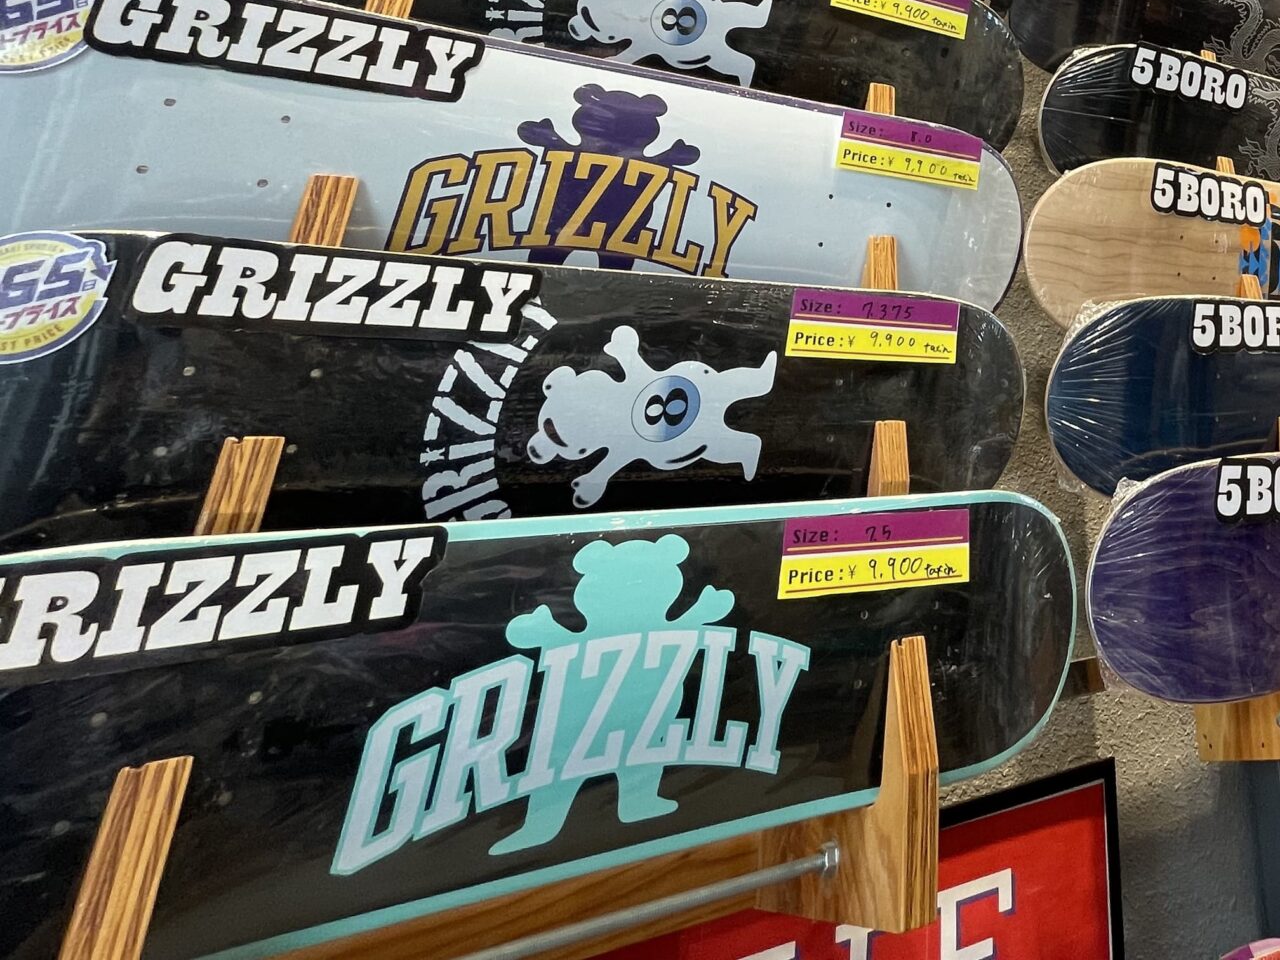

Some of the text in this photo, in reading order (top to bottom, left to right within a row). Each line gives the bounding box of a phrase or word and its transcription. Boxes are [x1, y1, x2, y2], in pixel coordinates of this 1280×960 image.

[385, 147, 758, 278] GRIZZLY
[132, 241, 534, 333] GRIZZLY
[792, 527, 839, 544] Size:
[0, 536, 435, 671] RIZZLY
[330, 626, 811, 876] GRIZZLY
